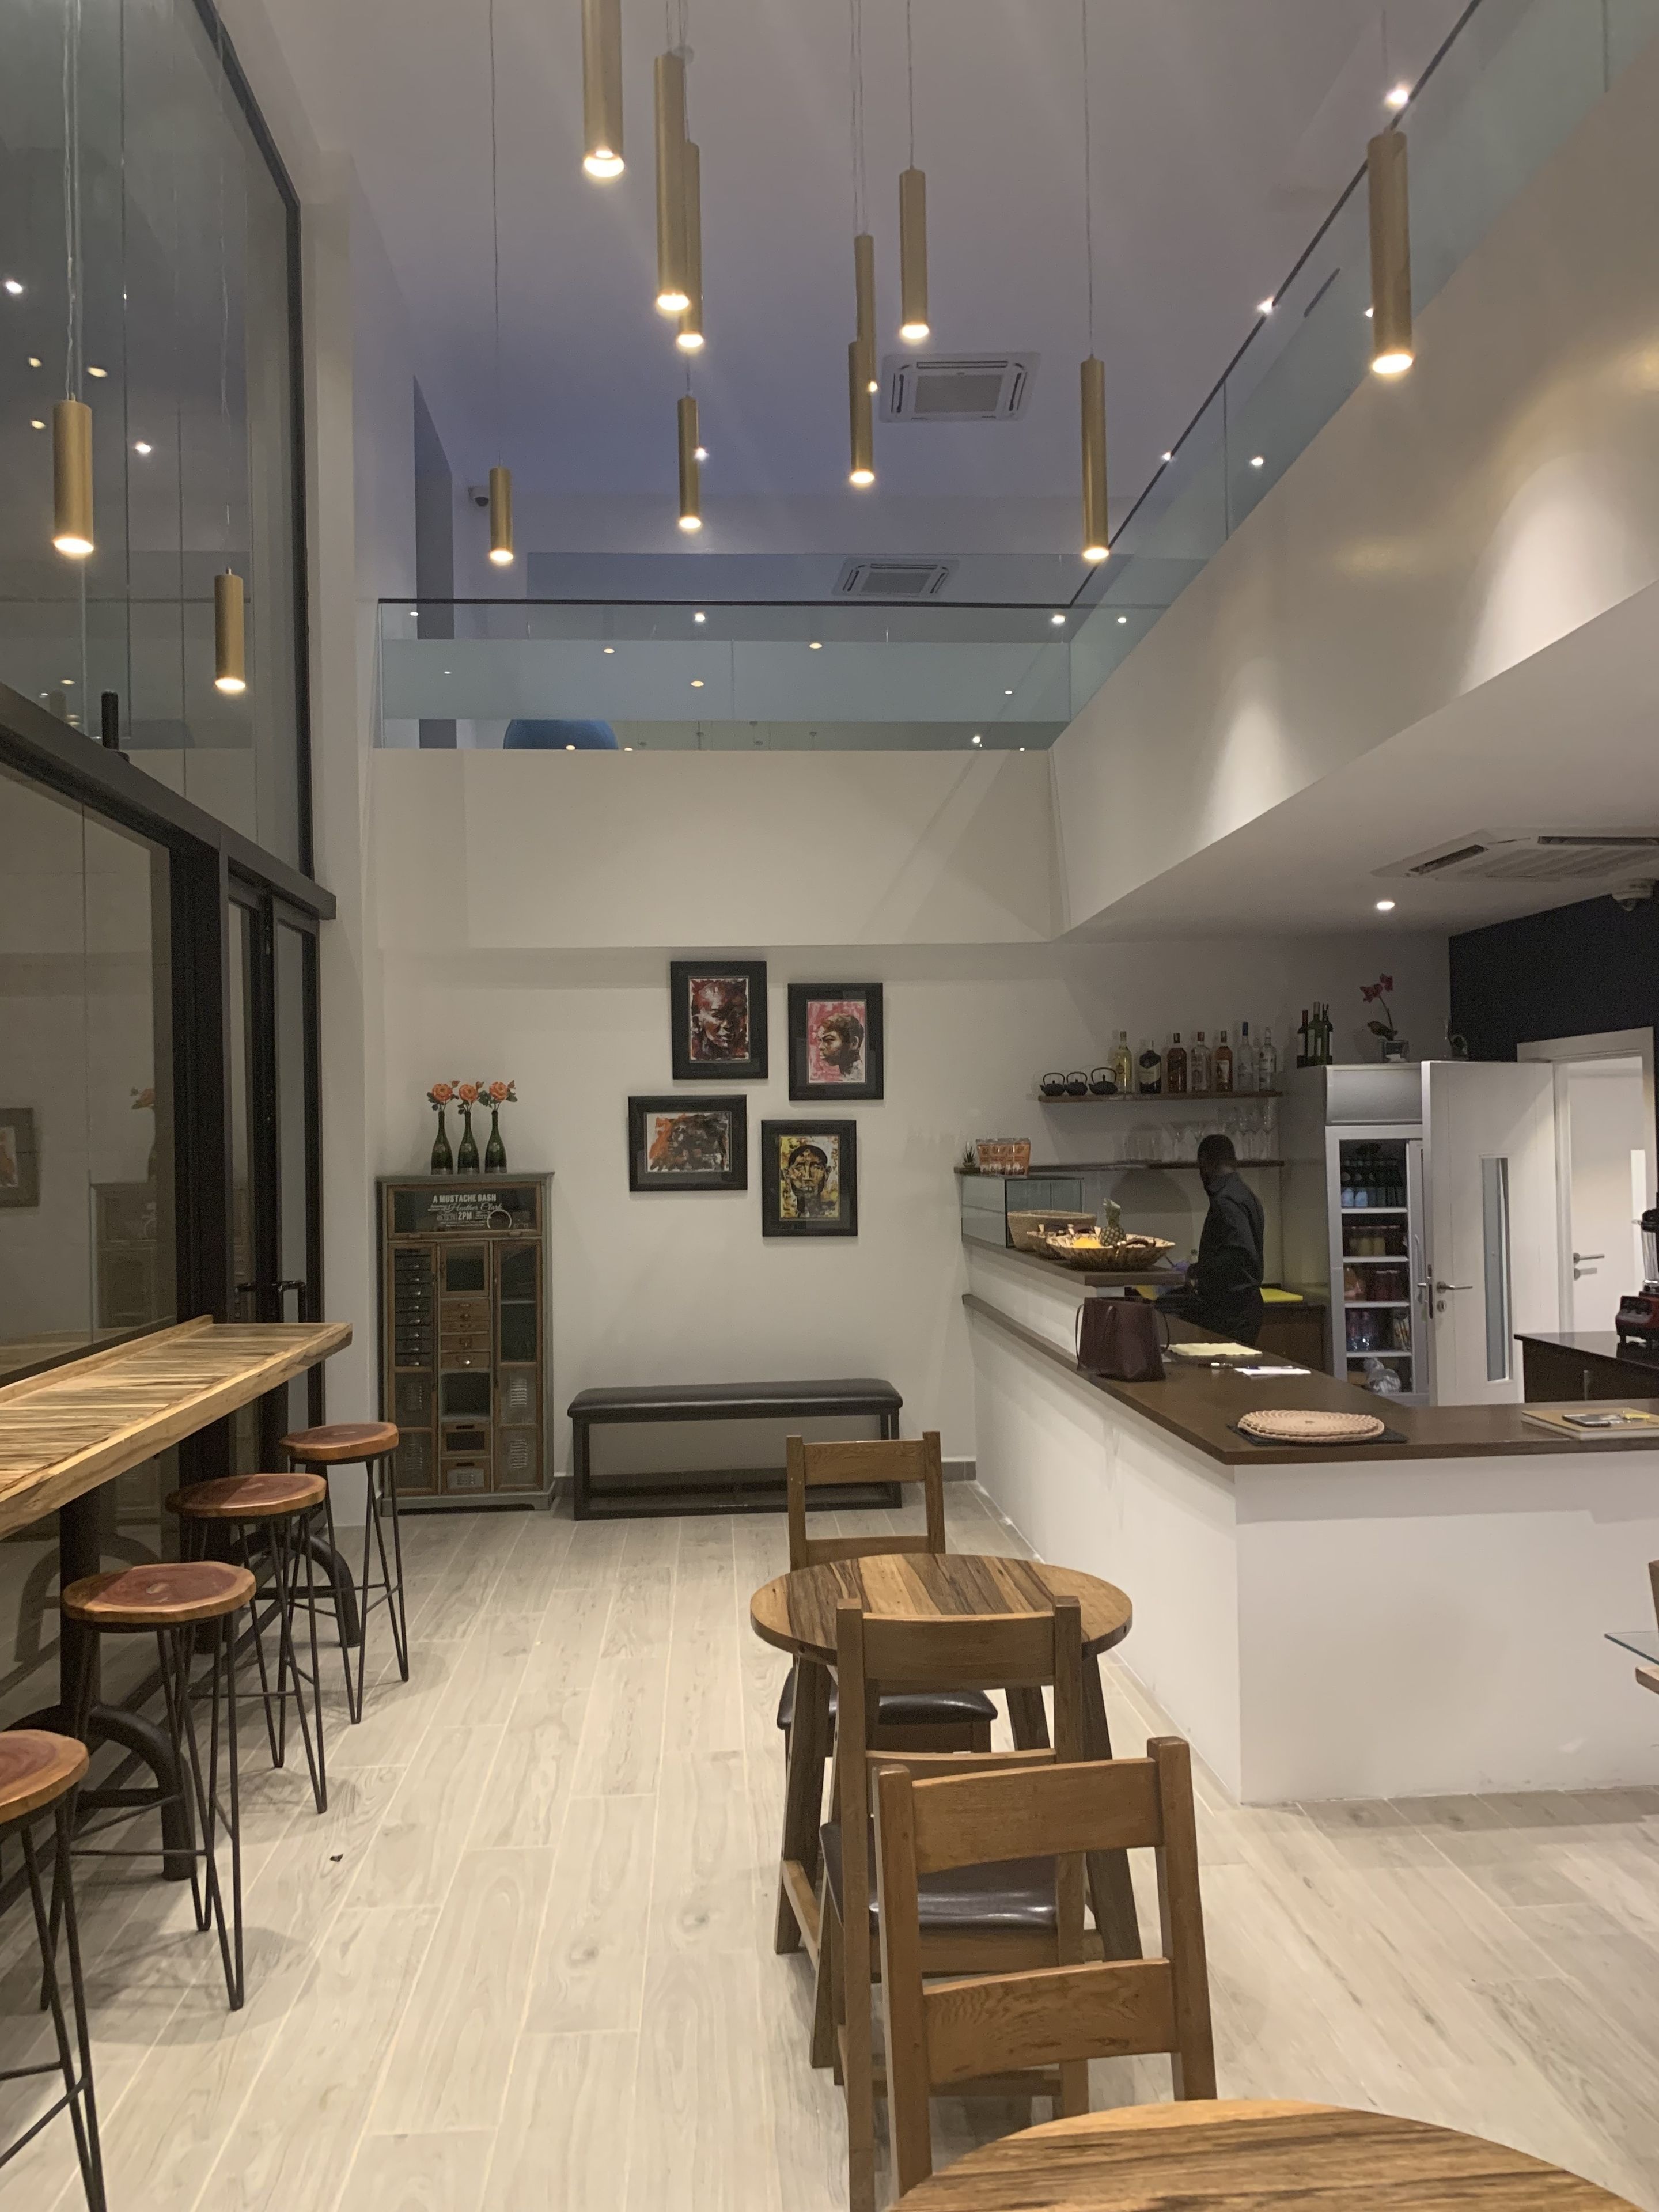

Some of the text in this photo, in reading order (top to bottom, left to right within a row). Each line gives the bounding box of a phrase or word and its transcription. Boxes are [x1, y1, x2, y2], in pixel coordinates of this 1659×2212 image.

[433, 1194, 497, 1203] A MUSTACHE BASH
[458, 1211, 472, 1221] 2PM
